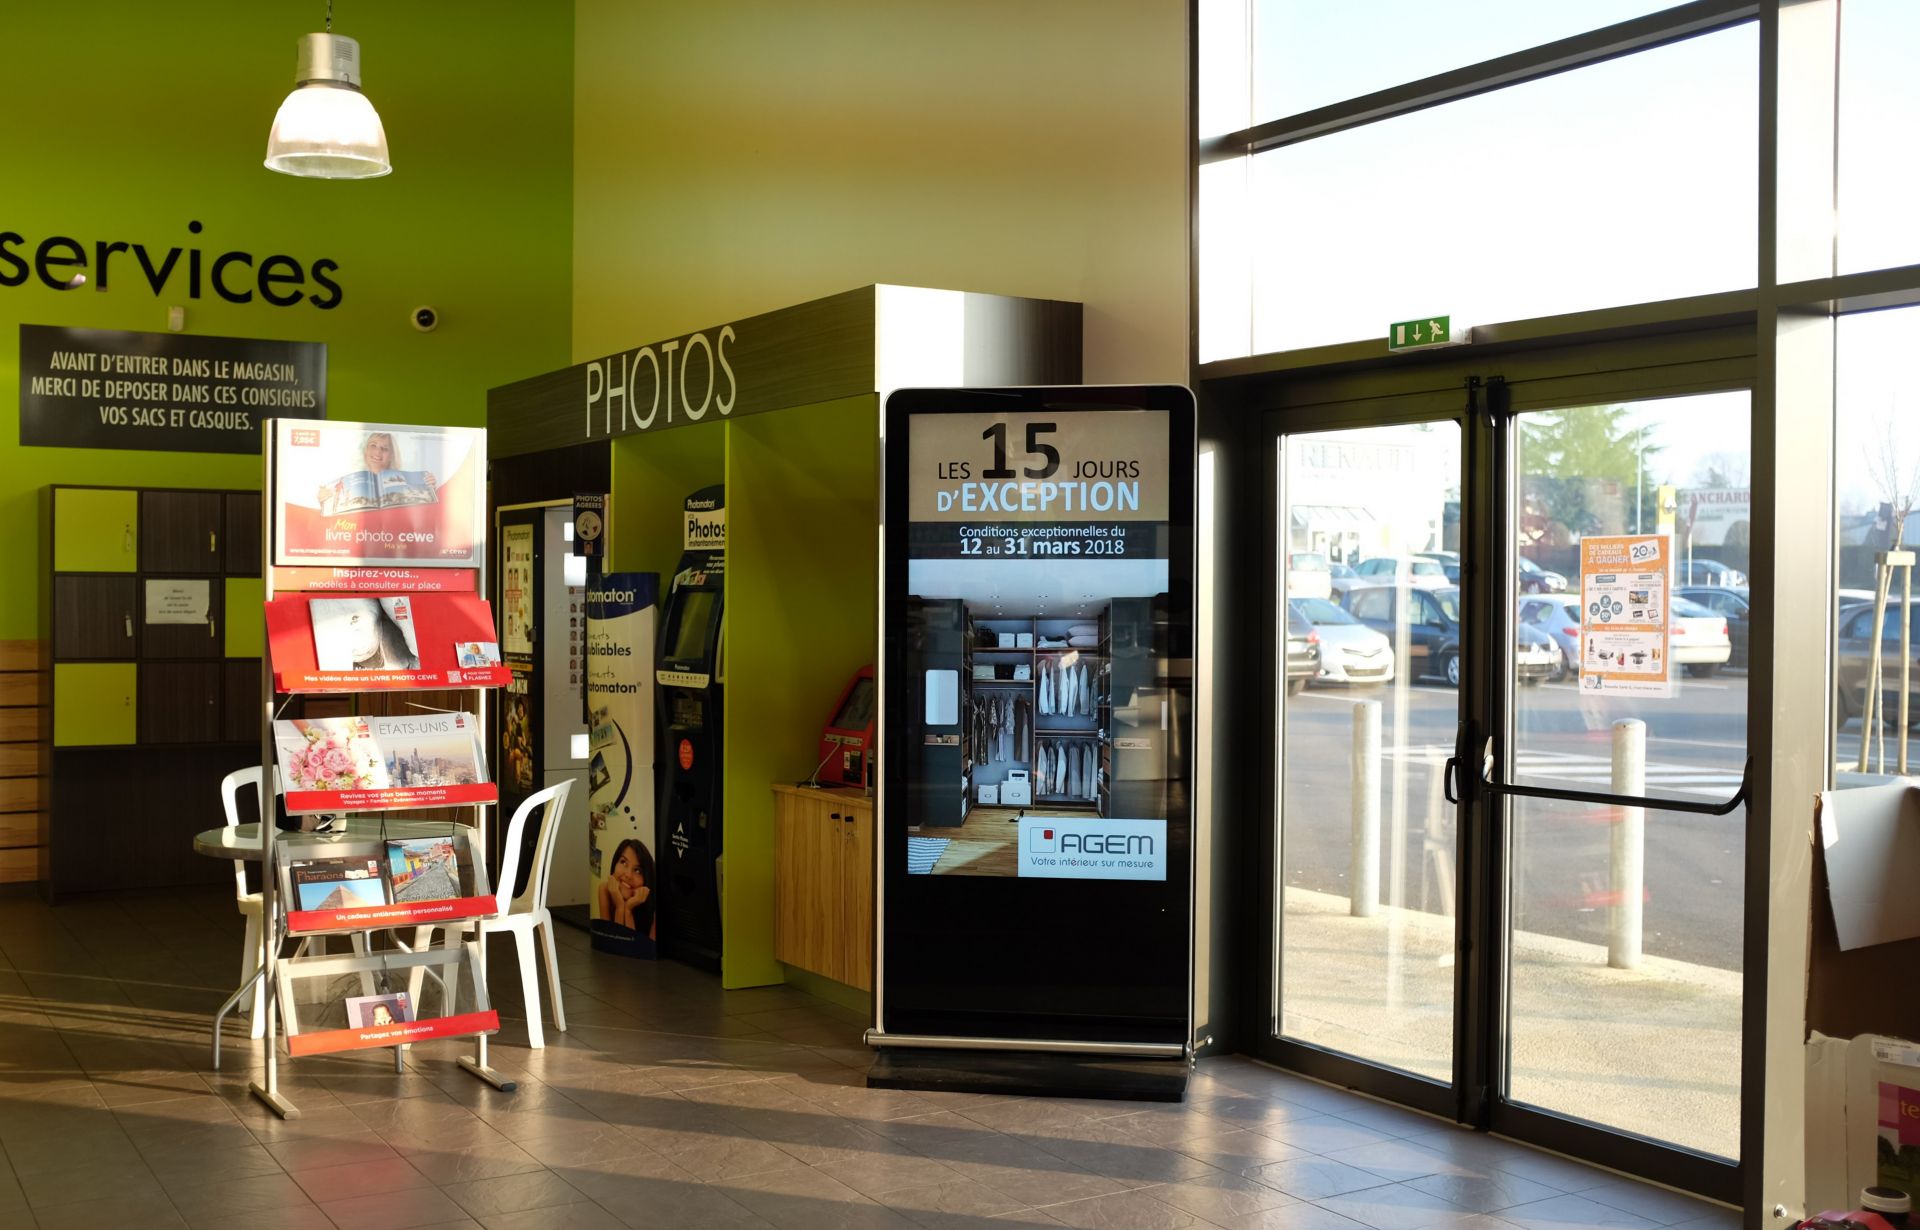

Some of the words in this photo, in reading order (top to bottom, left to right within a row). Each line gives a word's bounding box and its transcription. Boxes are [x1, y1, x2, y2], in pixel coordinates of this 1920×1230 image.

[0, 220, 343, 310] services
[50, 351, 96, 372] AVANT
[101, 354, 168, 375] D'ENTRER
[173, 358, 210, 378] DANS
[215, 361, 229, 379] LE
[233, 362, 299, 385] MAGASIN,
[586, 325, 737, 438] PHOTOS
[32, 377, 77, 397] MERCI
[81, 379, 101, 398] DE
[105, 380, 169, 401] DEPOSER
[173, 384, 210, 403] DANS
[214, 385, 237, 405] CES
[241, 387, 316, 408] CONSIGNES
[100, 406, 128, 425] VOS
[132, 407, 166, 427] SACS
[170, 410, 185, 428] ET
[189, 410, 253, 431] CASQUES.
[938, 462, 971, 479] LES
[982, 422, 1061, 479] 15
[1073, 460, 1140, 479] JOURS
[937, 481, 1139, 512] D'EXCEPTION
[336, 519, 357, 530] Mon
[959, 526, 1019, 538] Conditions
[1021, 526, 1108, 538] exceptionnelles
[1110, 526, 1125, 537] du
[325, 529, 351, 541] livre
[355, 529, 394, 543] photo
[398, 532, 434, 543] cewe
[960, 538, 983, 555] 12
[986, 545, 1000, 555] au
[1004, 538, 1028, 555] 31
[1033, 540, 1081, 555] mars
[1084, 540, 1124, 555] 2018
[309, 580, 348, 589] modèles
[350, 580, 356, 588] à
[358, 580, 400, 589] consulter
[418, 580, 442, 590] place
[1061, 833, 1154, 855] AGEM
[1031, 857, 1056, 866] Votre
[1059, 858, 1098, 867] intérieur
[347, 912, 371, 920] cadeau
[413, 906, 453, 916] personnalisé
[360, 1031, 390, 1040] Partagez
[1901, 1100, 1920, 1119] te
